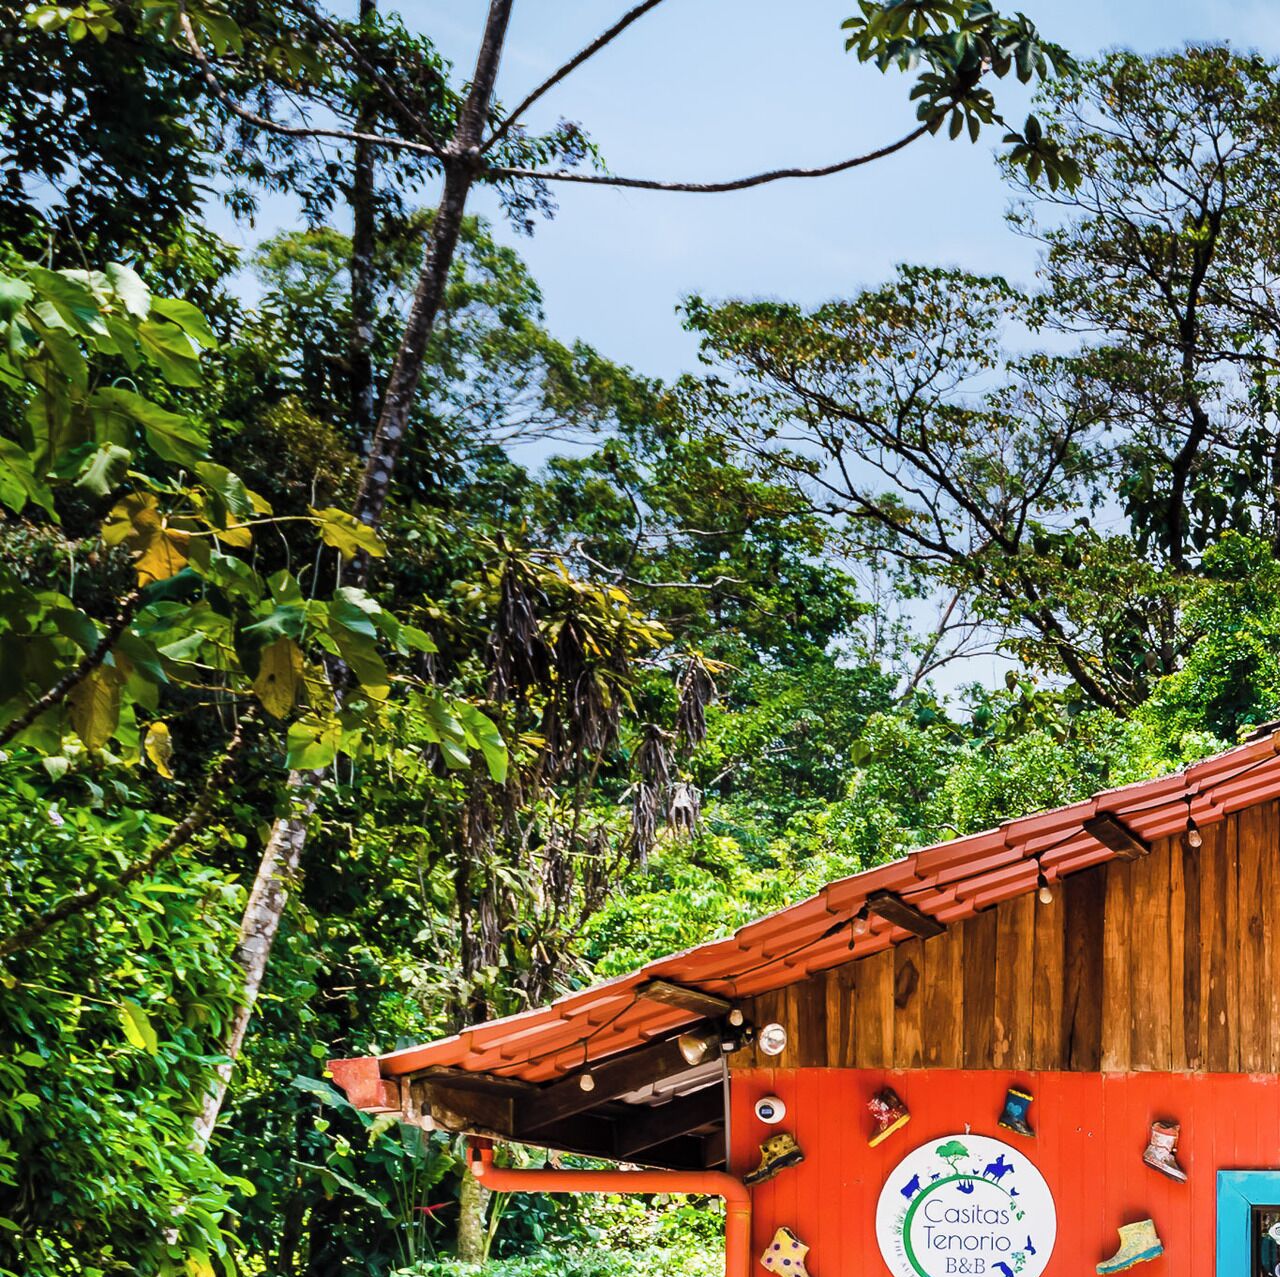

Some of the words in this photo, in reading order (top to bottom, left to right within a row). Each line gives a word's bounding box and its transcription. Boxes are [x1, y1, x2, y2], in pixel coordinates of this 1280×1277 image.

[924, 1199, 1010, 1225] Casitas
[923, 1225, 1011, 1251] Tenorio
[945, 1257, 986, 1274] B&B
